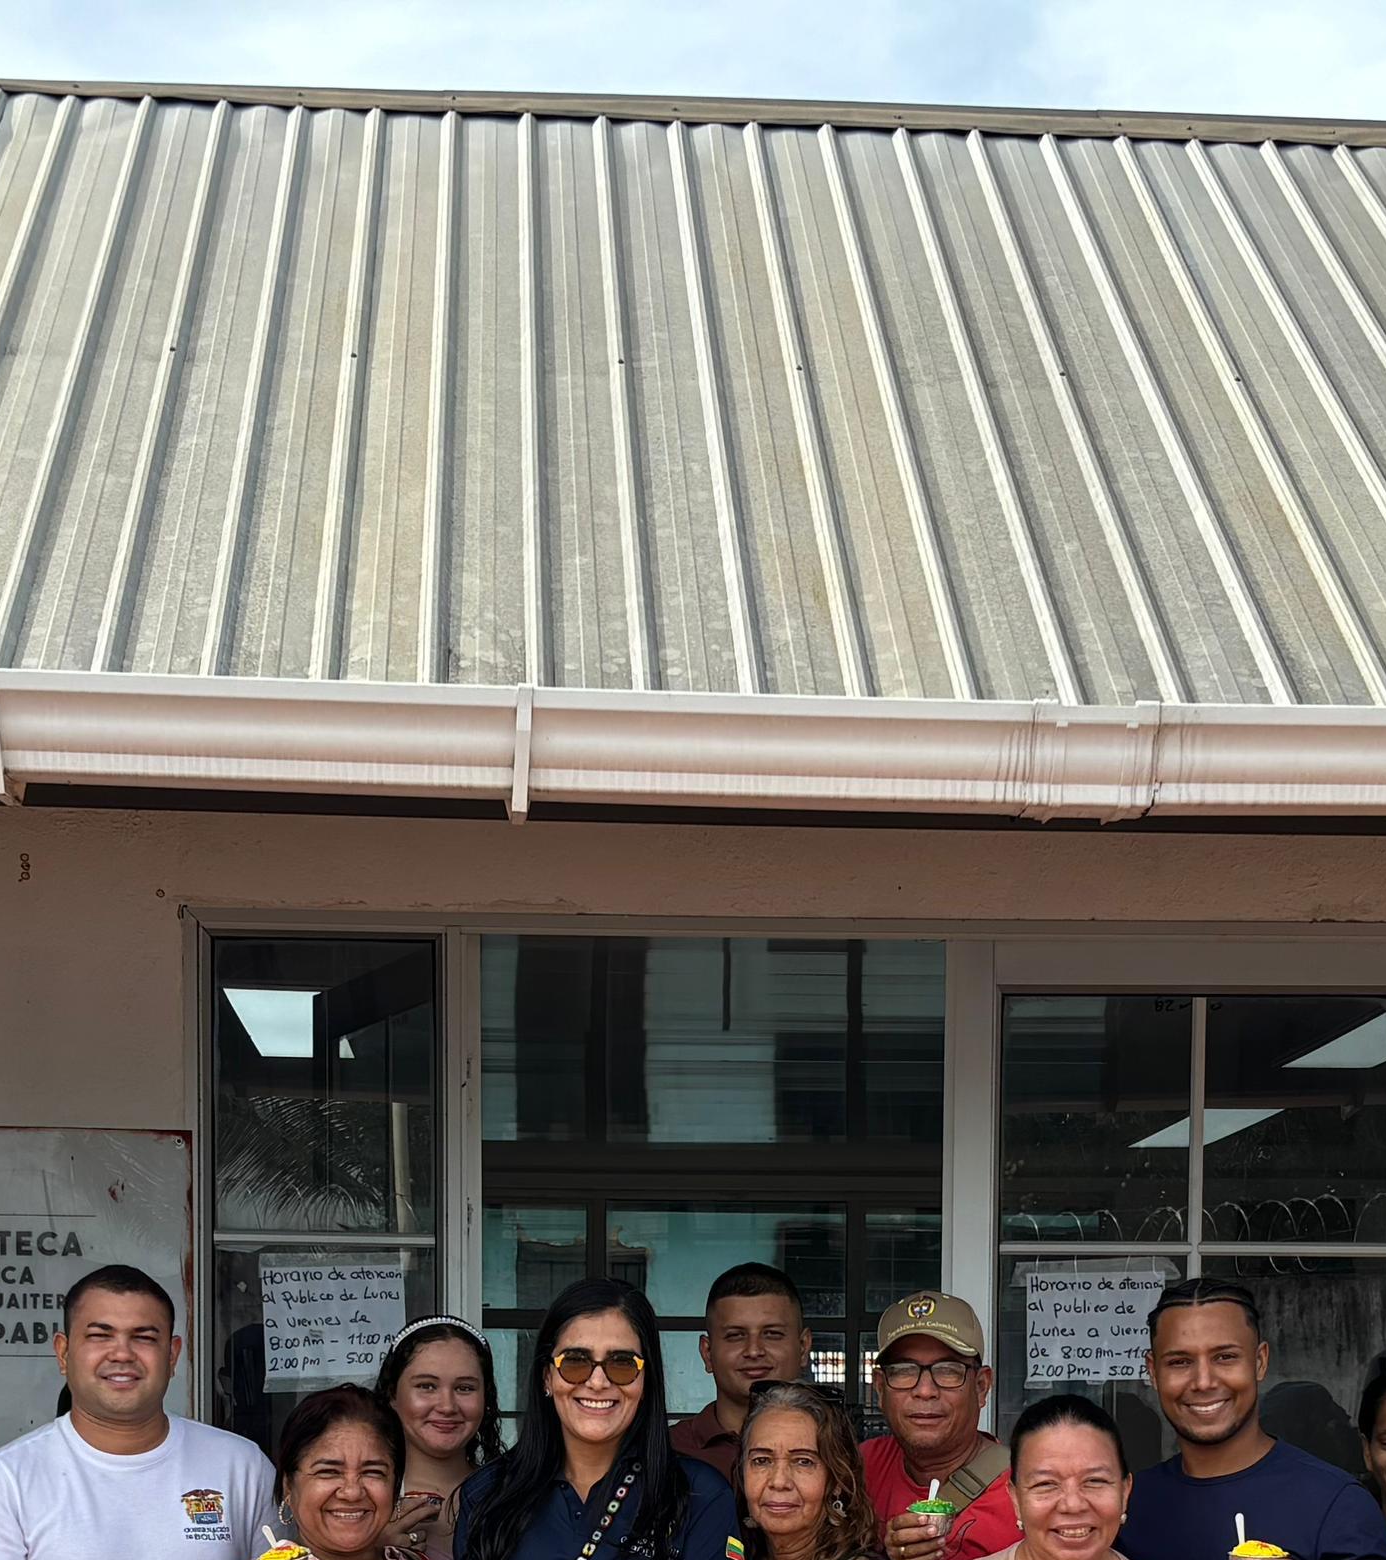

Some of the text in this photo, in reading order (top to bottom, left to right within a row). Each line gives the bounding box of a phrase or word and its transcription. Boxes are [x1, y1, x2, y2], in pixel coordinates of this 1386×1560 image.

[263, 1269, 322, 1285] Horario
[328, 1267, 346, 1280] de
[1030, 1276, 1092, 1294] Horario
[1098, 1277, 1113, 1291] de
[263, 1291, 276, 1304] al
[340, 1288, 358, 1301] de
[1028, 1301, 1044, 1313] al
[1114, 1301, 1136, 1314] de
[1029, 1321, 1076, 1339] Lunes
[1087, 1327, 1099, 1338] a
[1029, 1342, 1049, 1359] de
[268, 1357, 298, 1372] 2:00
[1030, 1364, 1063, 1378] 2:00
